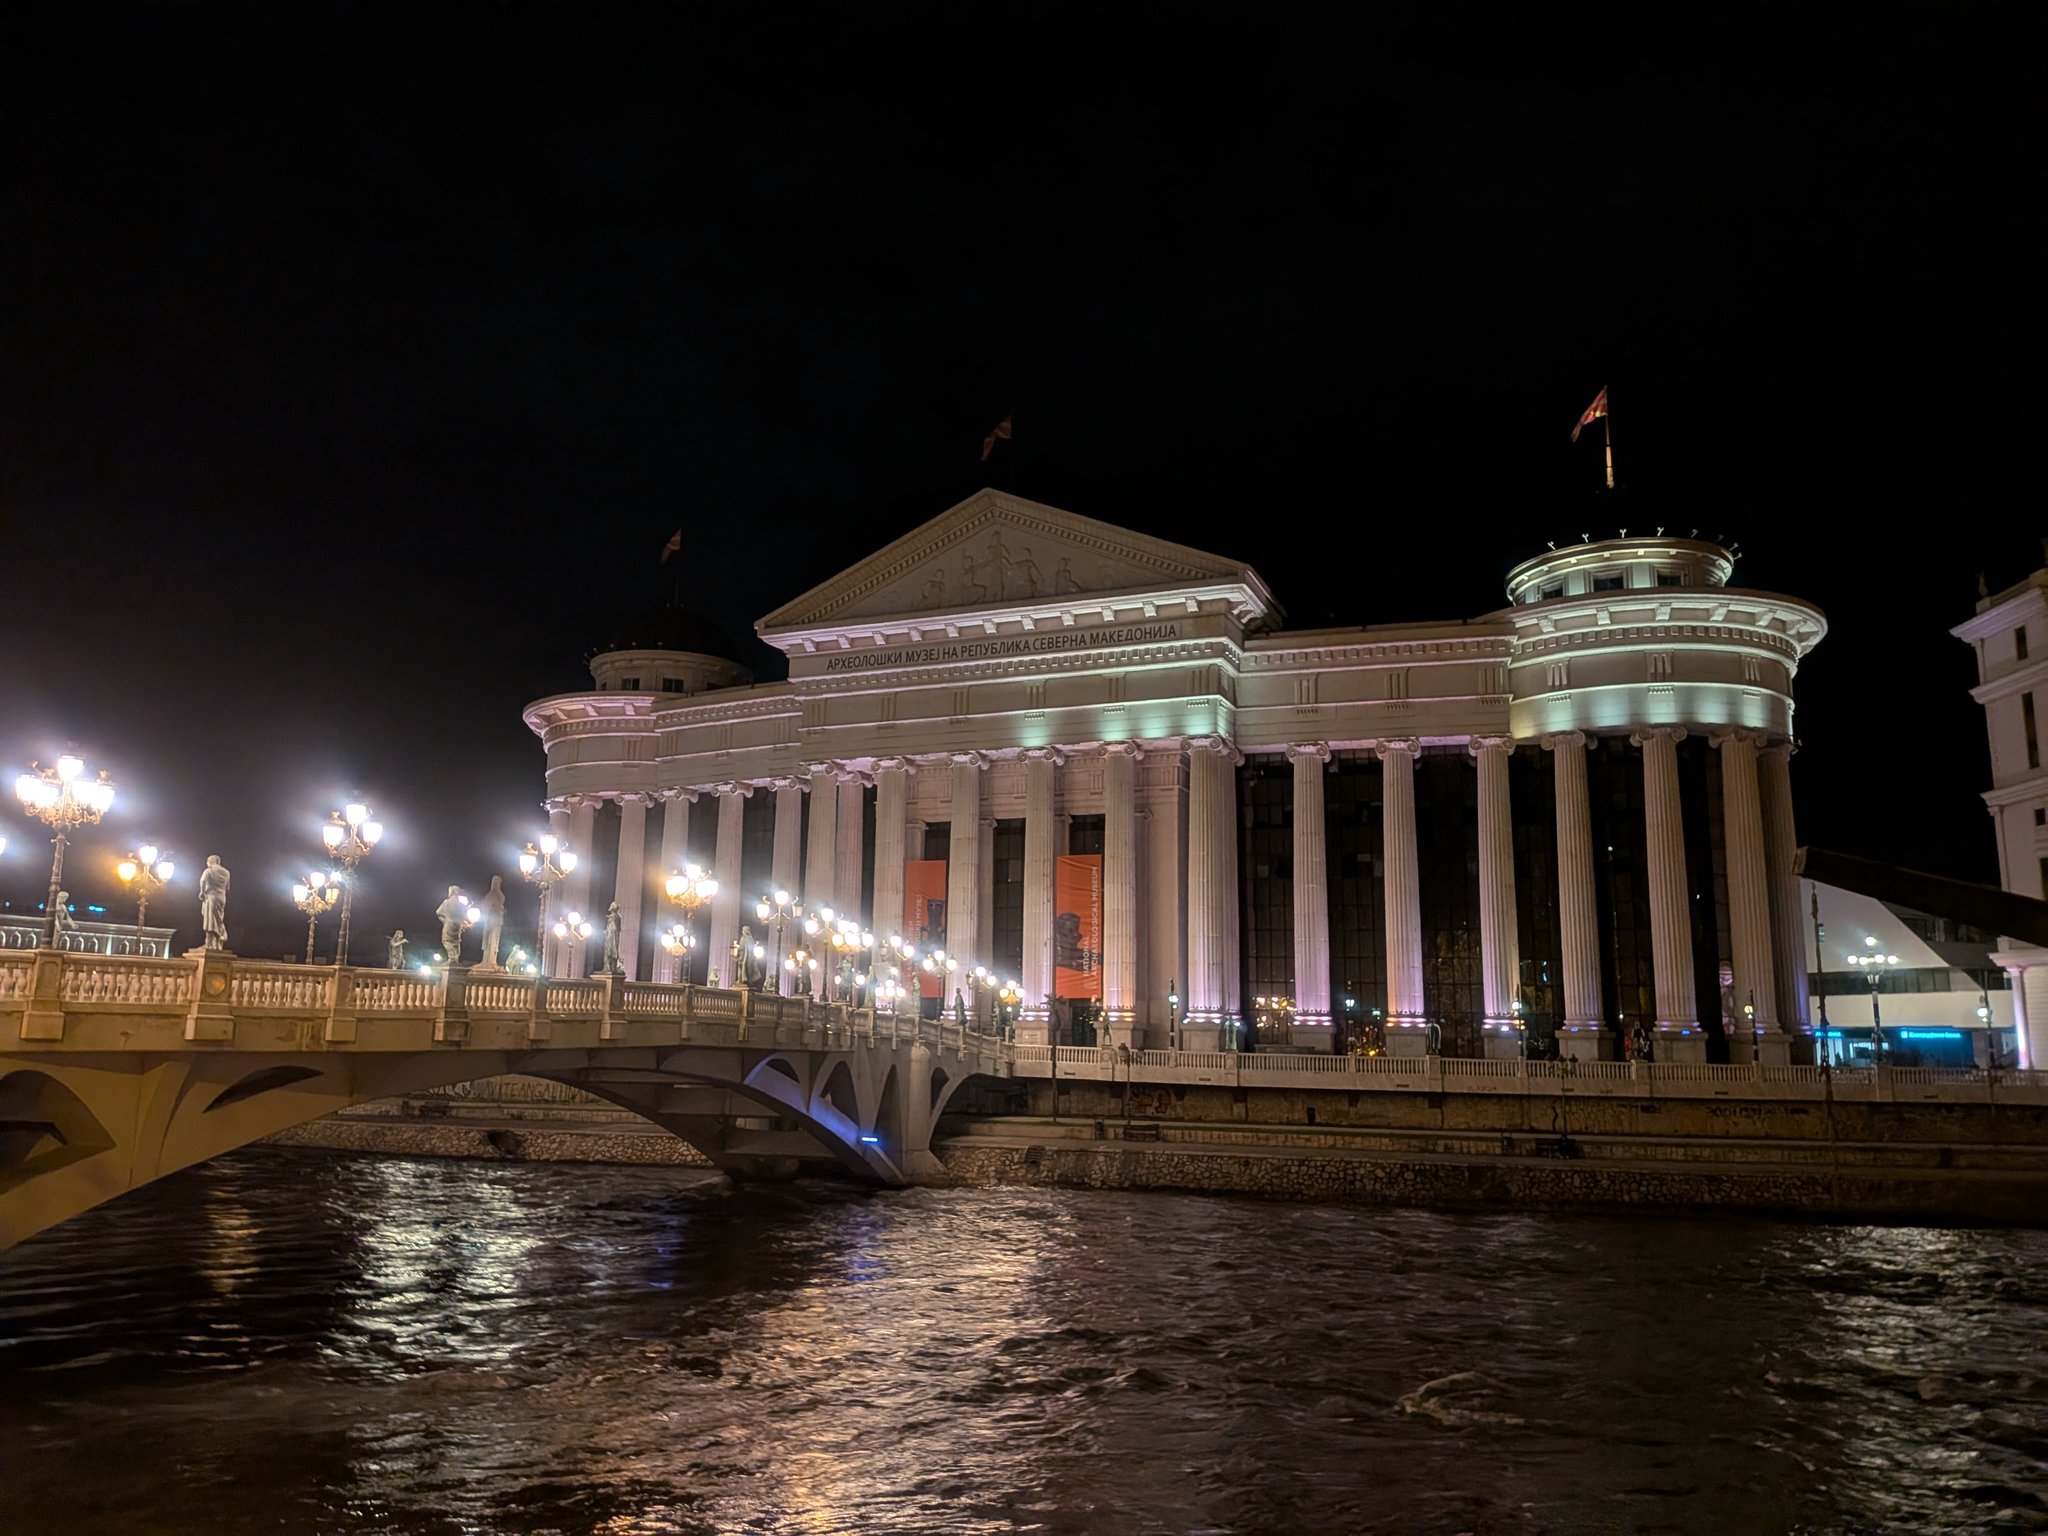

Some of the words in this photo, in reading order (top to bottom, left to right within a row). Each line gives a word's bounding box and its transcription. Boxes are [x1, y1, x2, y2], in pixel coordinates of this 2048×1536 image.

[826, 651, 902, 671] АРХЕОЛОШКИ
[905, 648, 941, 663] МУЗЕЈ
[942, 647, 959, 660] НА
[960, 639, 1031, 658] РЕПУБЛИКА
[1032, 634, 1087, 650] СЕВЕРНА
[1089, 624, 1177, 645] МАКЕДОНИЈА
[1091, 866, 1099, 901] MUSEUM
[1083, 937, 1091, 977] NATIONAL
[1091, 902, 1099, 976] ARCHAEOLOGICAL
